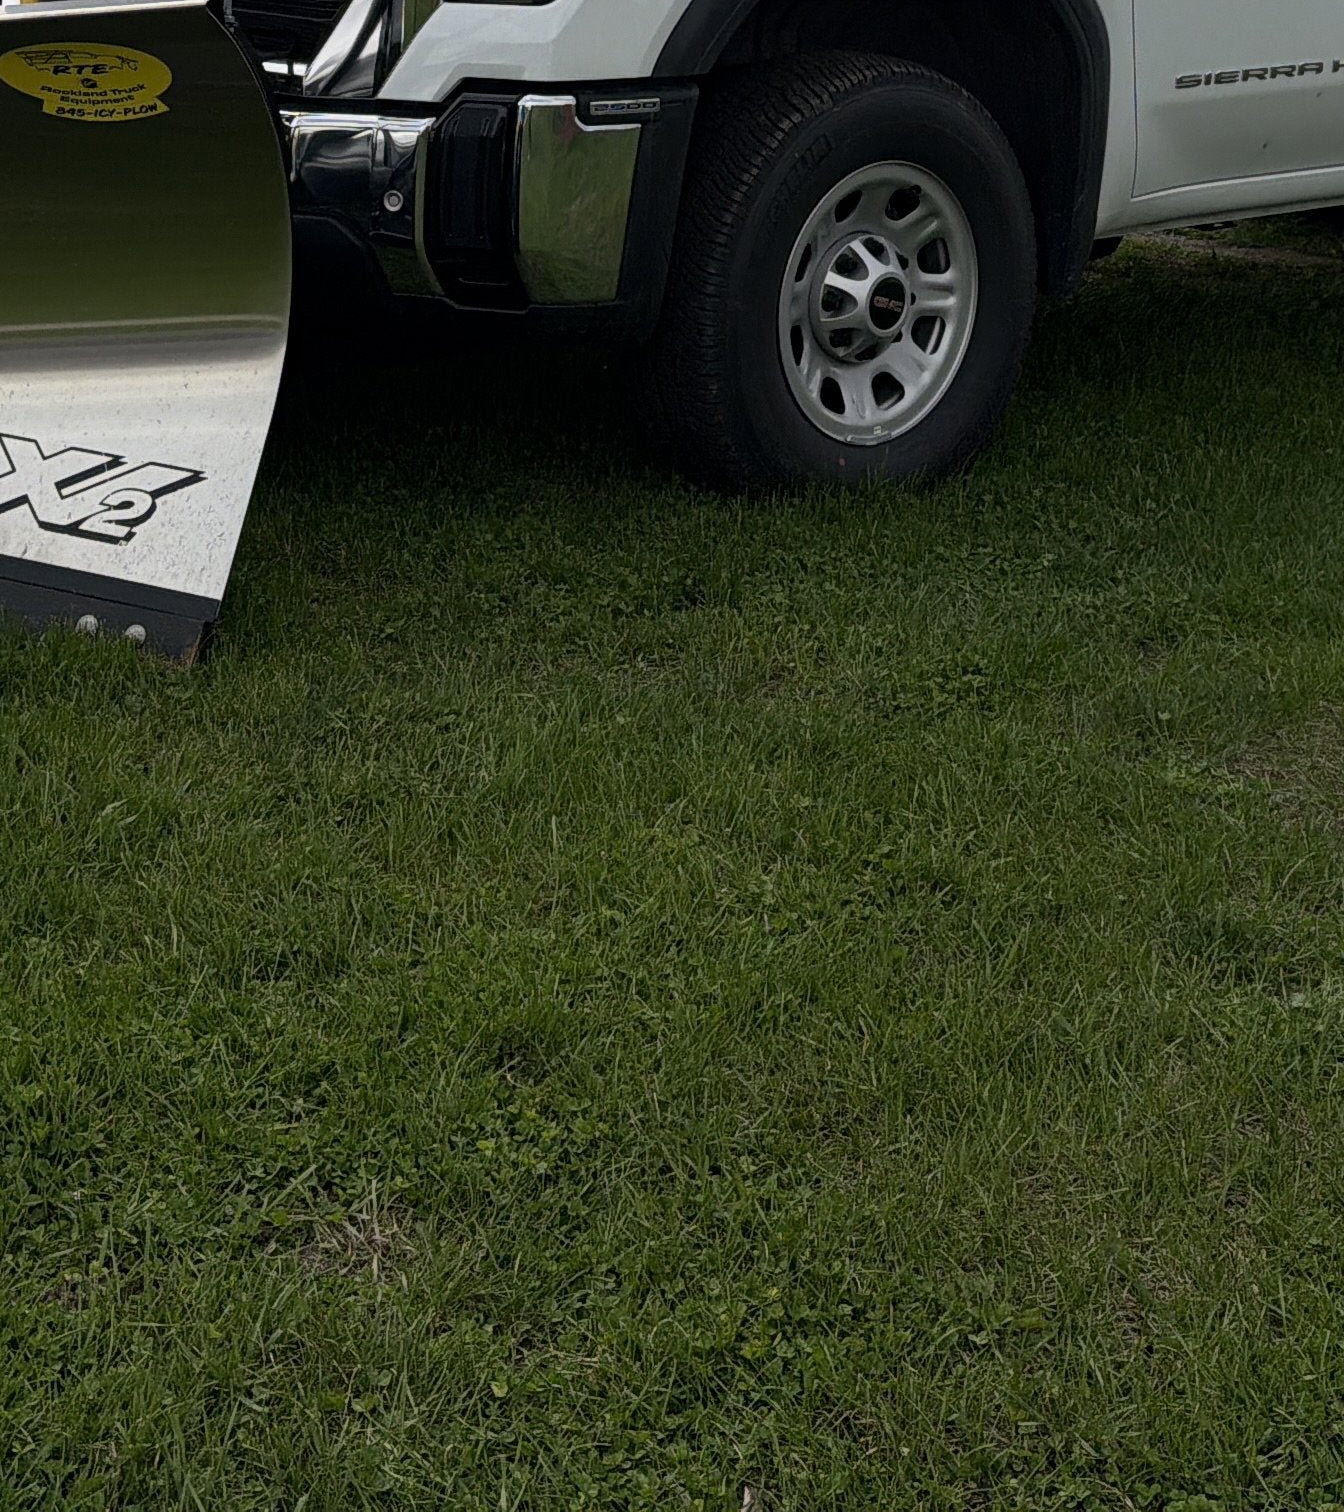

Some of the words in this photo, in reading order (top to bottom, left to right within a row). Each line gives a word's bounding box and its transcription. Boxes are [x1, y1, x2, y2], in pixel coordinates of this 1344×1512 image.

[52, 64, 110, 76] RTE
[1174, 61, 1324, 90] SIERRA
[111, 83, 147, 96] Truck
[59, 95, 135, 106] Equipment
[55, 102, 158, 118] 845-ICY-PLOW
